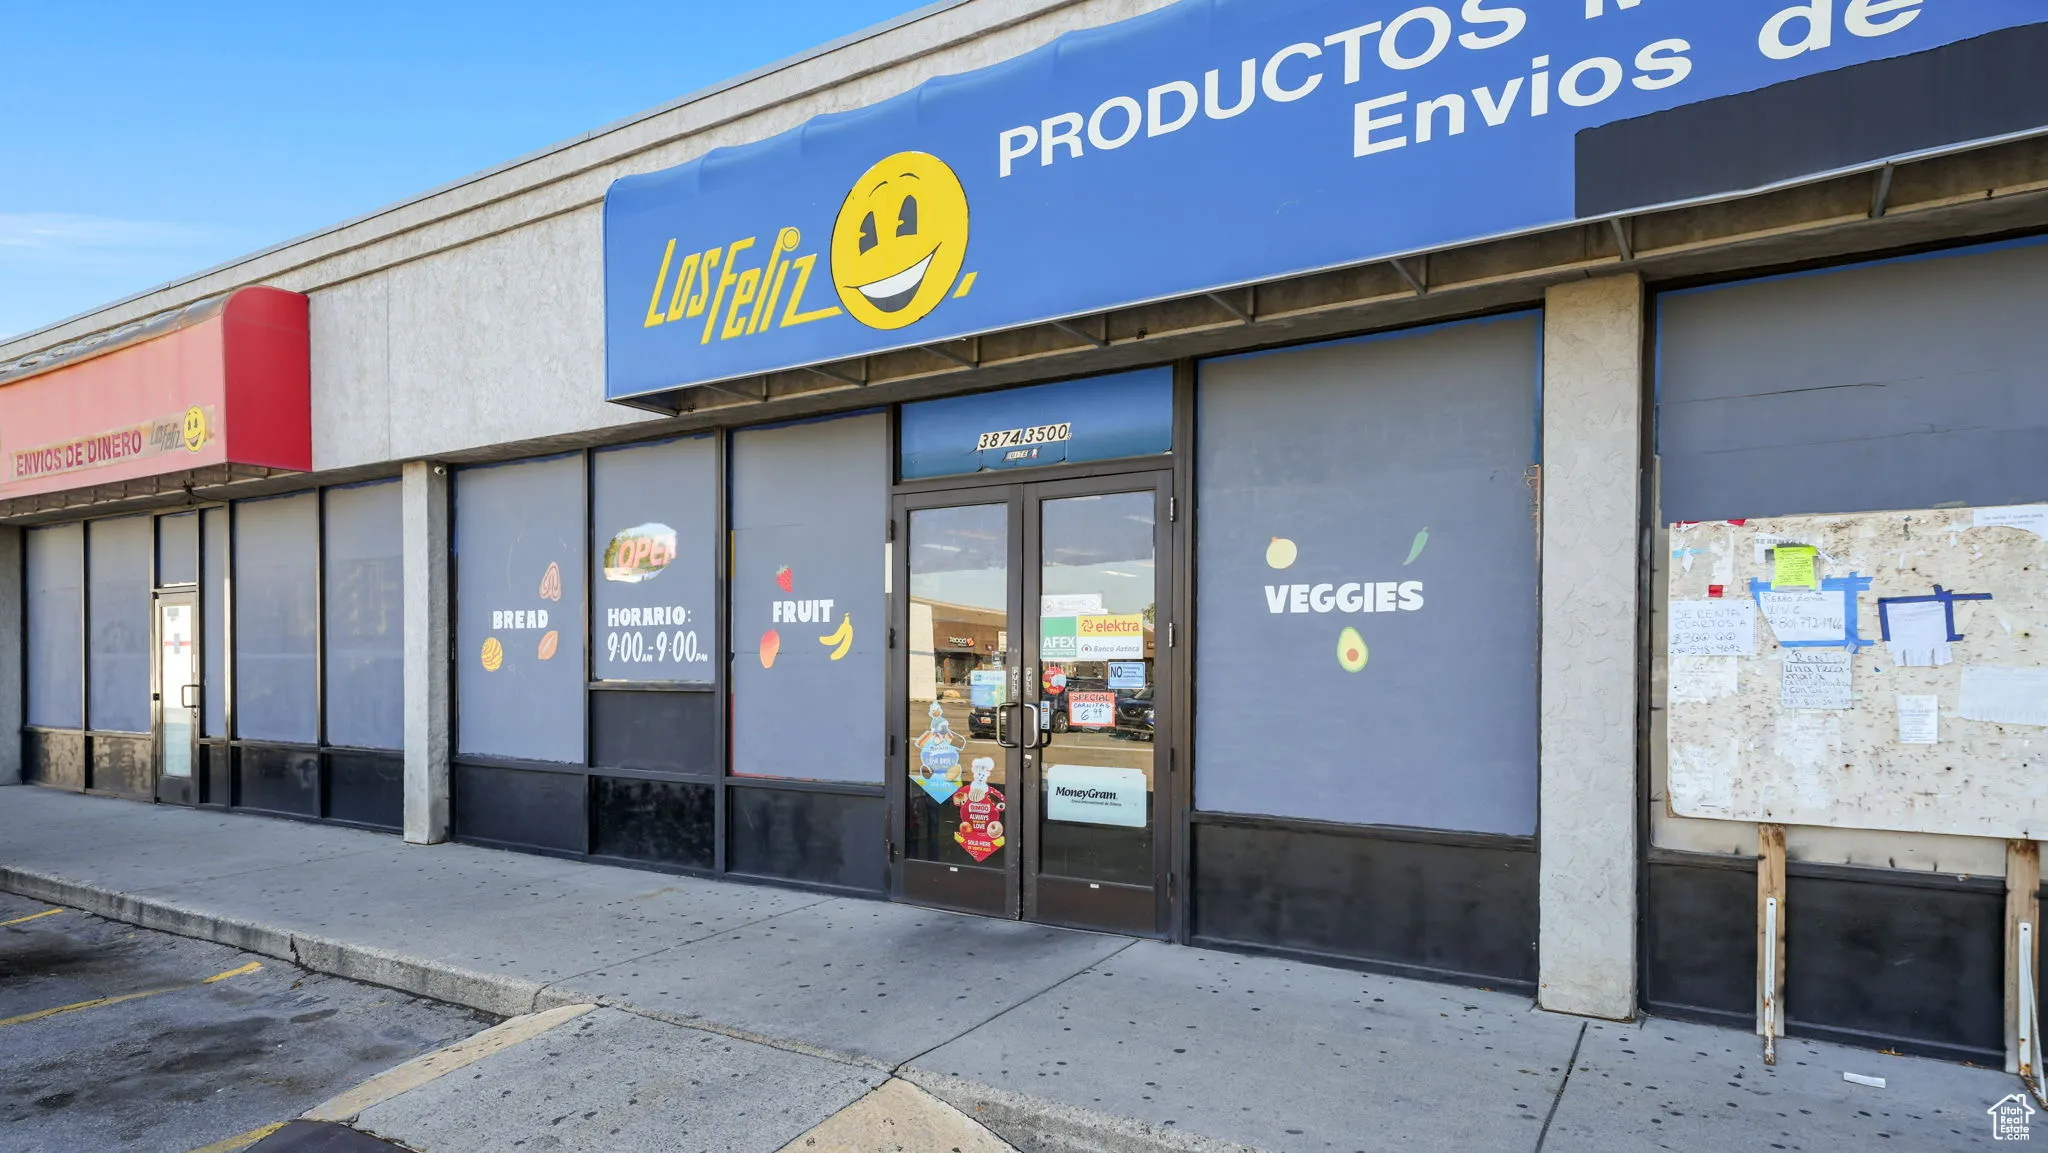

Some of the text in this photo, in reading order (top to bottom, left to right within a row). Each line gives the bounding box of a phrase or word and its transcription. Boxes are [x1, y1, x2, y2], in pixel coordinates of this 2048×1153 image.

[999, 0, 1526, 178] PRODUCTOS
[1353, 0, 1924, 158] Envios de
[16, 430, 142, 477] ENVIOS DE DINERO
[1264, 580, 1425, 614] VEGGIES
[493, 609, 549, 629] BREAD
[607, 605, 692, 627] HORARIO:
[772, 599, 834, 624] FRUIT
[1096, 619, 1139, 633] elektra
[1042, 636, 1076, 648] AFEX
[1110, 666, 1123, 678] NO
[1073, 693, 1111, 702] SPECIAL
[1055, 786, 1117, 800] MoneyGram
[969, 813, 989, 821] ALWAYS
